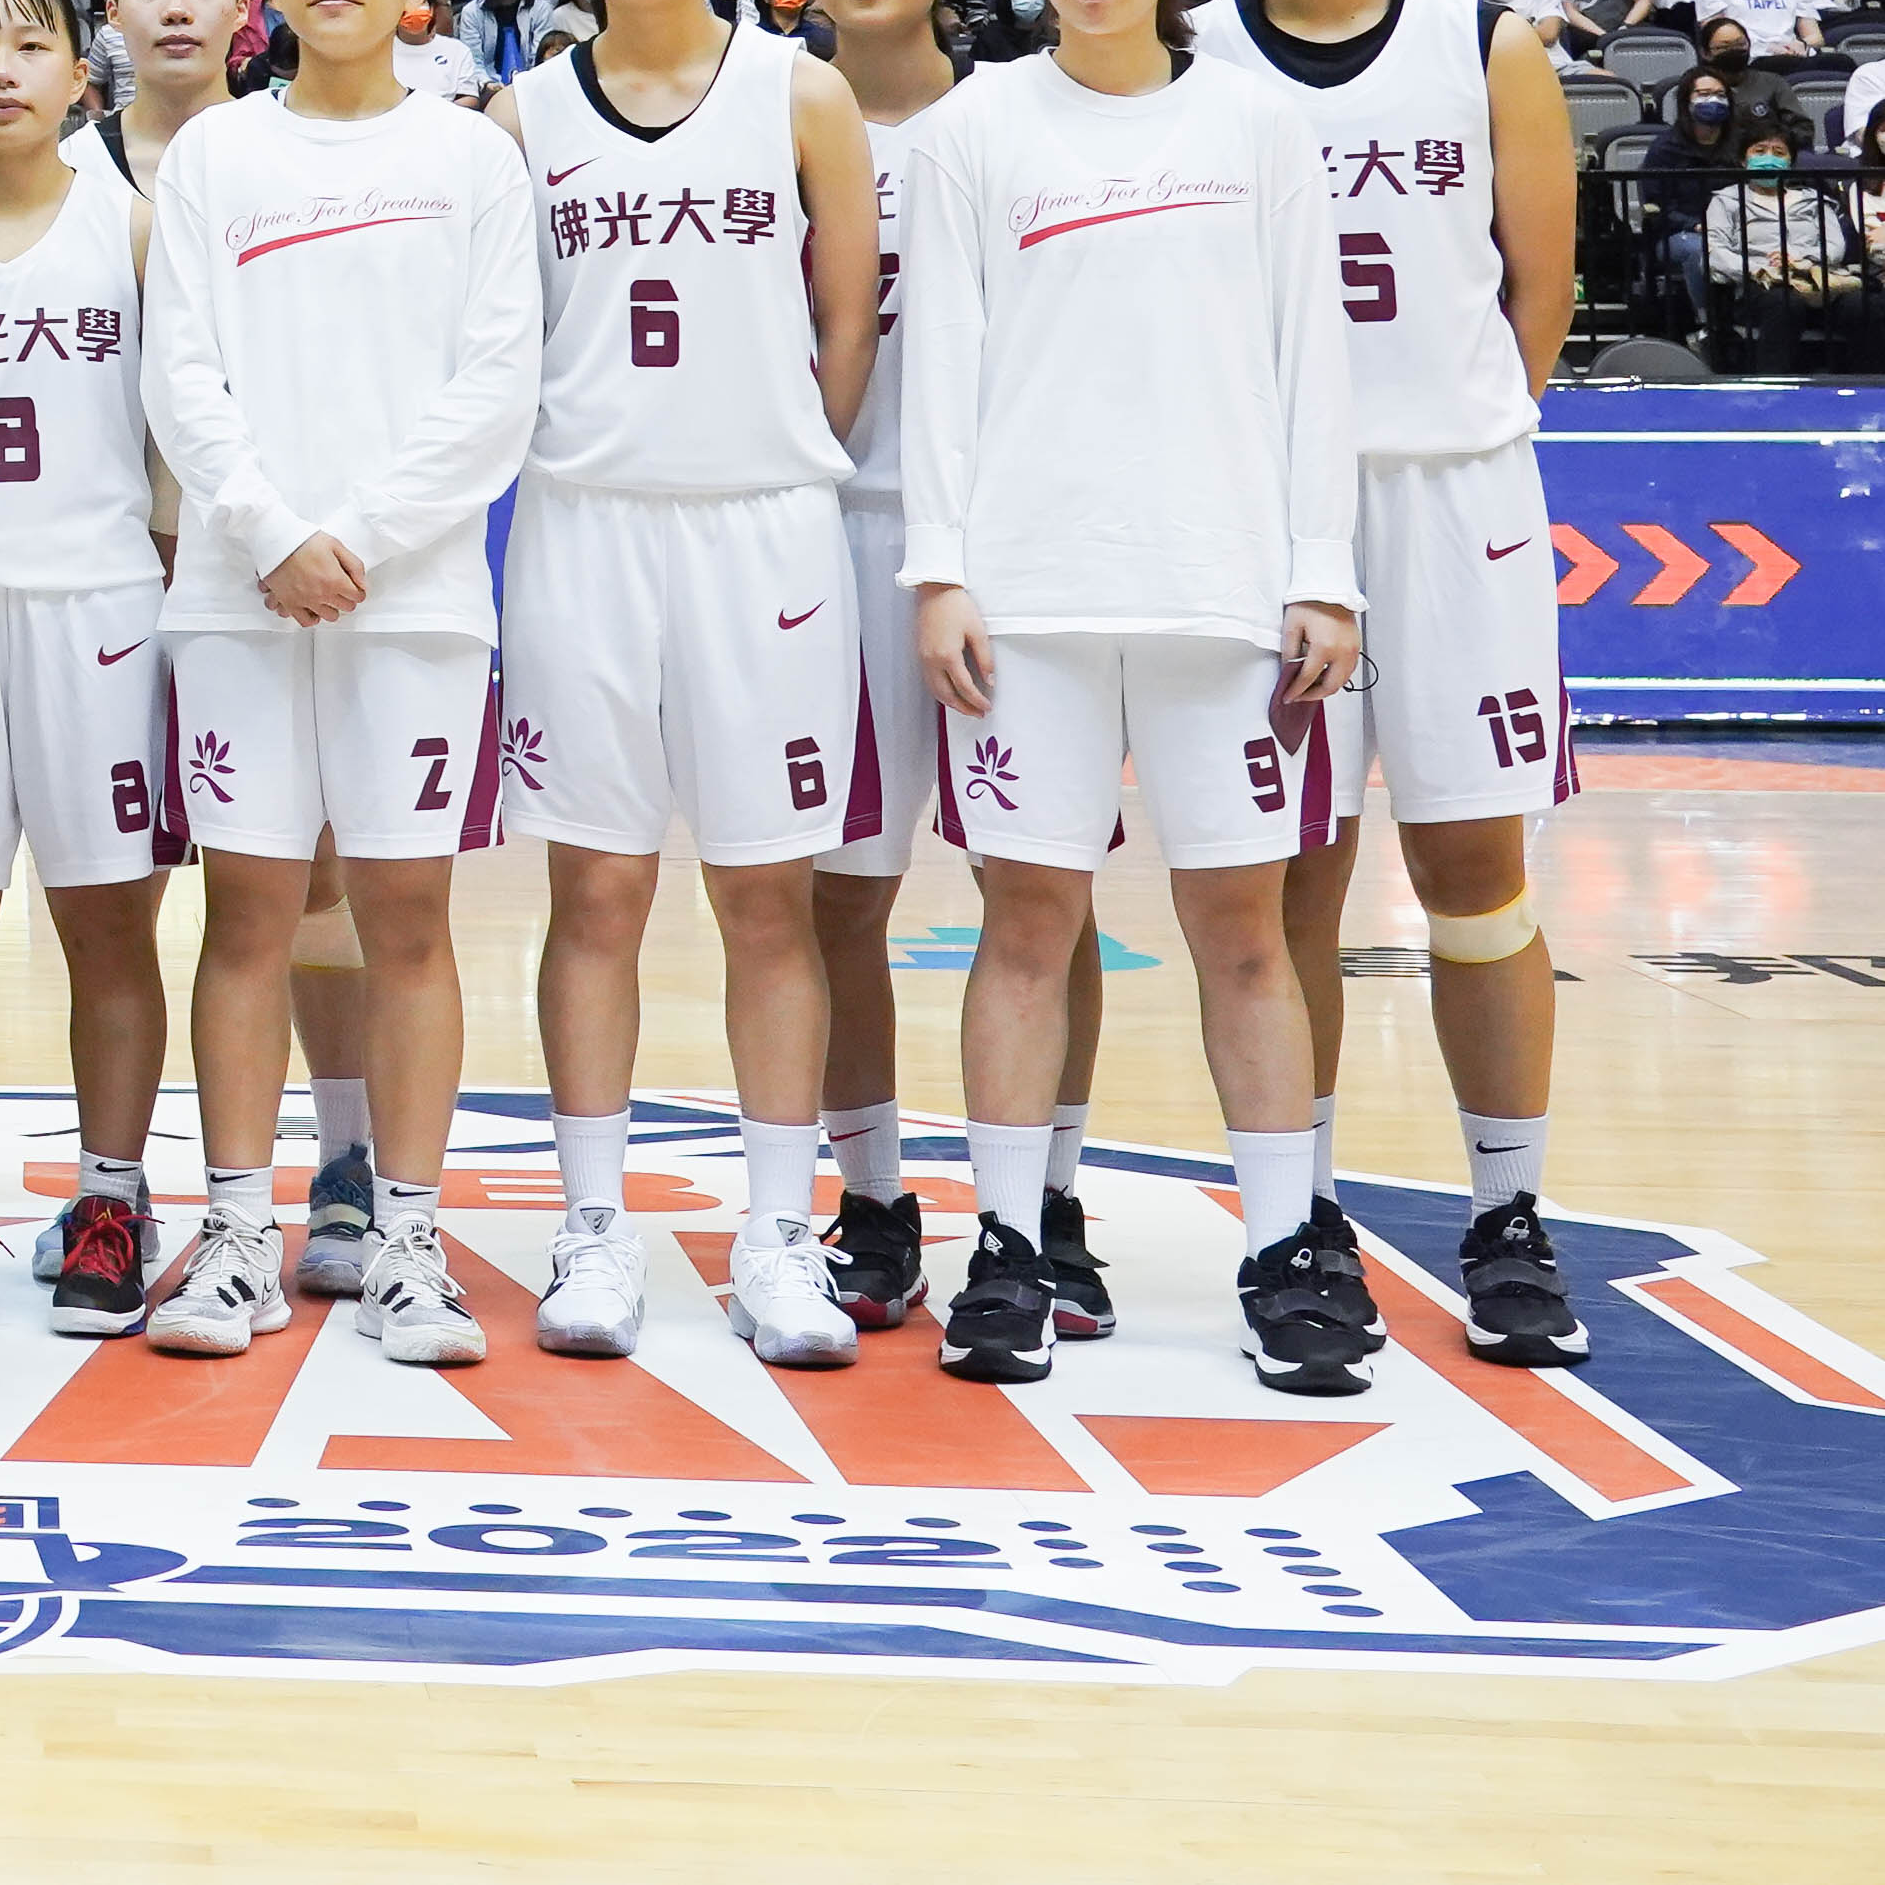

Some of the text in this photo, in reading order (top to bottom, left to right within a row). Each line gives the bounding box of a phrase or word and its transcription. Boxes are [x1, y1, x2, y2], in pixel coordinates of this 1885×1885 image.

[1008, 170, 1255, 242] Strive For Greatness
[1324, 139, 1465, 198] 大學
[225, 187, 459, 255] Strive For Greatness
[549, 187, 777, 259] 佛光大學
[1339, 233, 1398, 323] 5
[629, 279, 680, 368] 6
[1476, 688, 1548, 769] 15
[110, 760, 151, 835] 8
[410, 736, 453, 812] 2
[786, 736, 827, 812] 6
[1243, 736, 1285, 814] 9
[235, 1517, 1014, 1570] 2022
